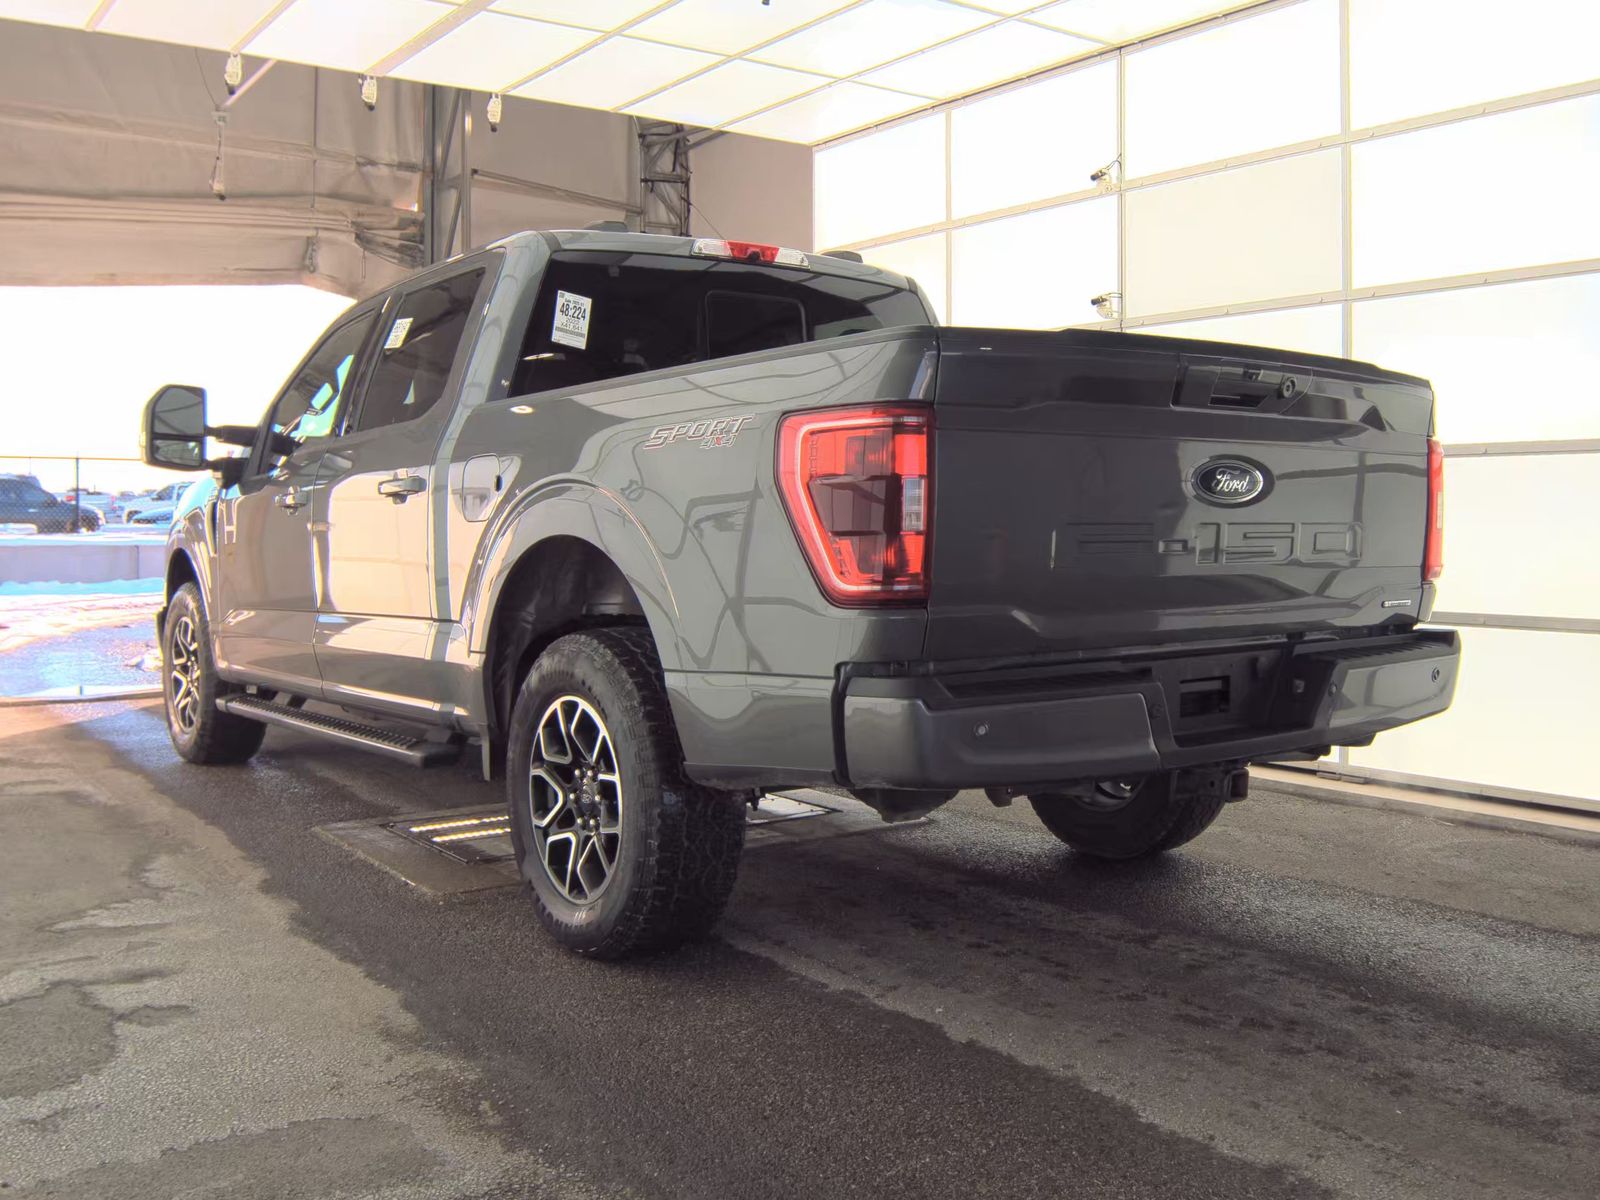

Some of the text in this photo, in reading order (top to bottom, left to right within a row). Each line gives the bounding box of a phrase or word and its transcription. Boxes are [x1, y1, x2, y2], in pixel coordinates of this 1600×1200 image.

[560, 302, 586, 321] 48:224
[643, 413, 754, 449] SPORT
[1211, 467, 1250, 492] Ford
[1051, 522, 1362, 567] F-150
